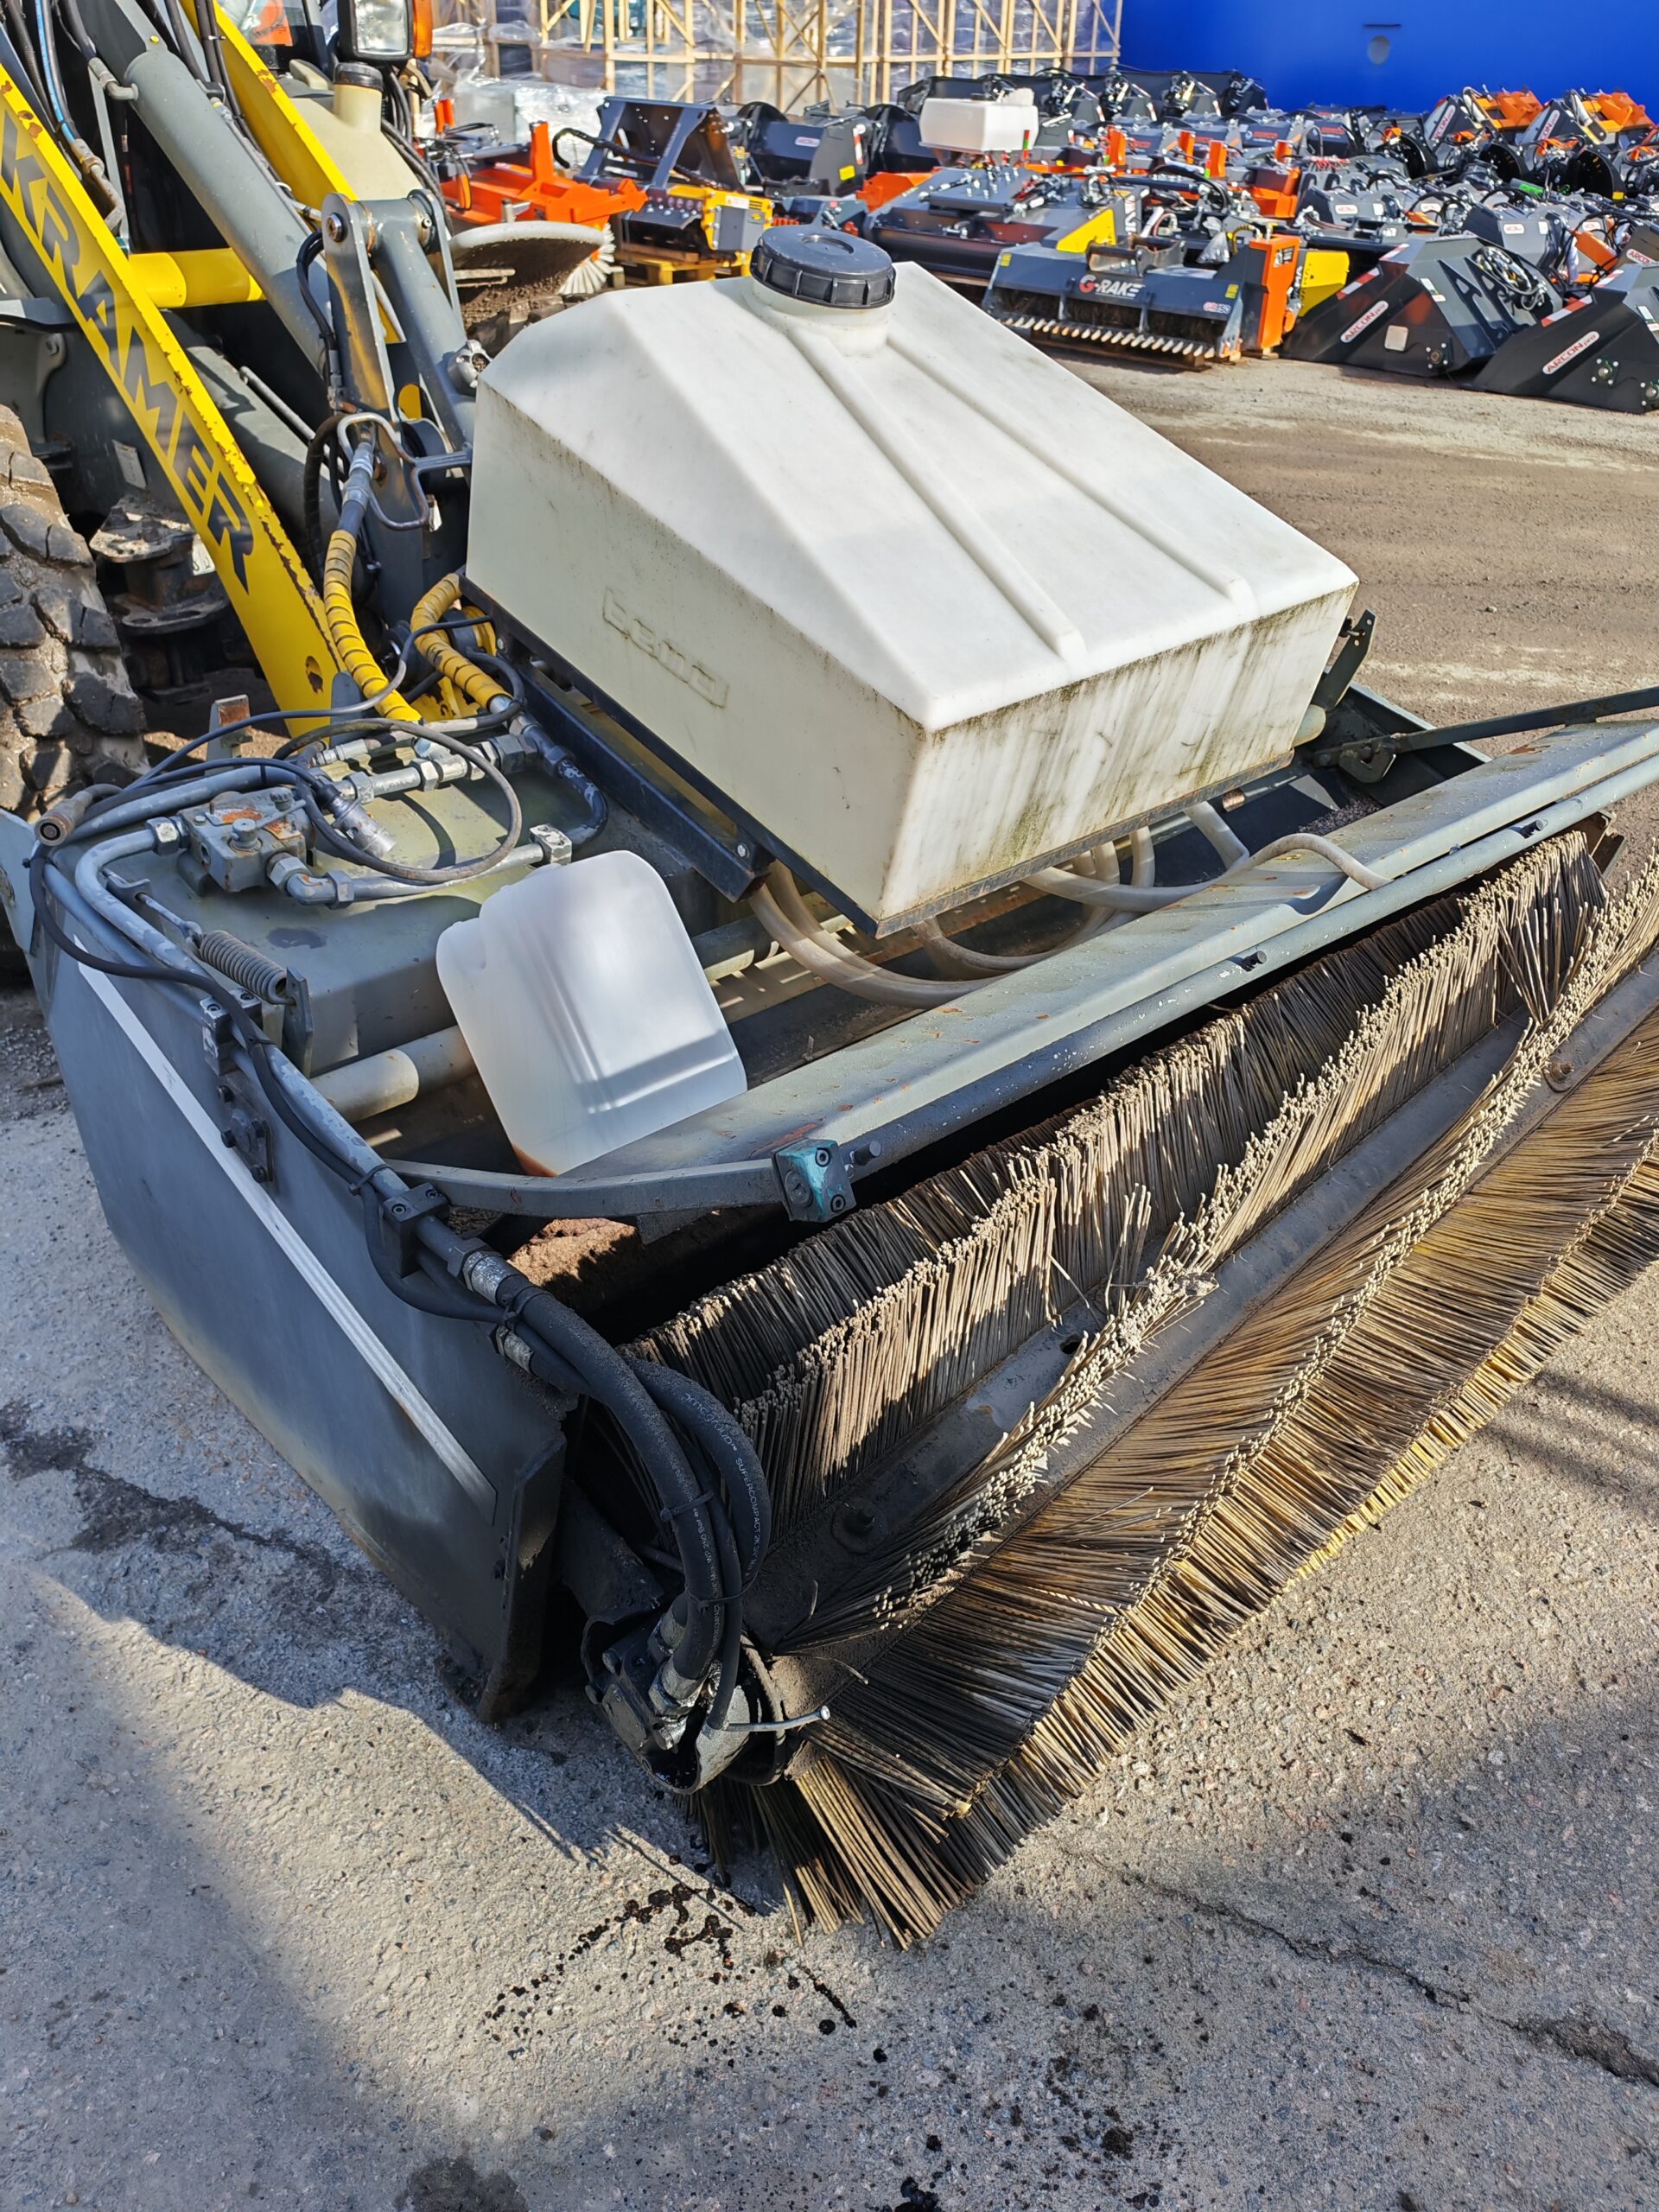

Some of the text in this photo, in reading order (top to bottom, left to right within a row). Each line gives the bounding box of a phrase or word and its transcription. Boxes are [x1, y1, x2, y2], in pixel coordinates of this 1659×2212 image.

[1, 111, 253, 594] KRAMER
[1344, 311, 1376, 341] ARCON
[1546, 334, 1597, 372] ARCON pro
[735, 1457, 760, 1533] SUPERCOMPACT
